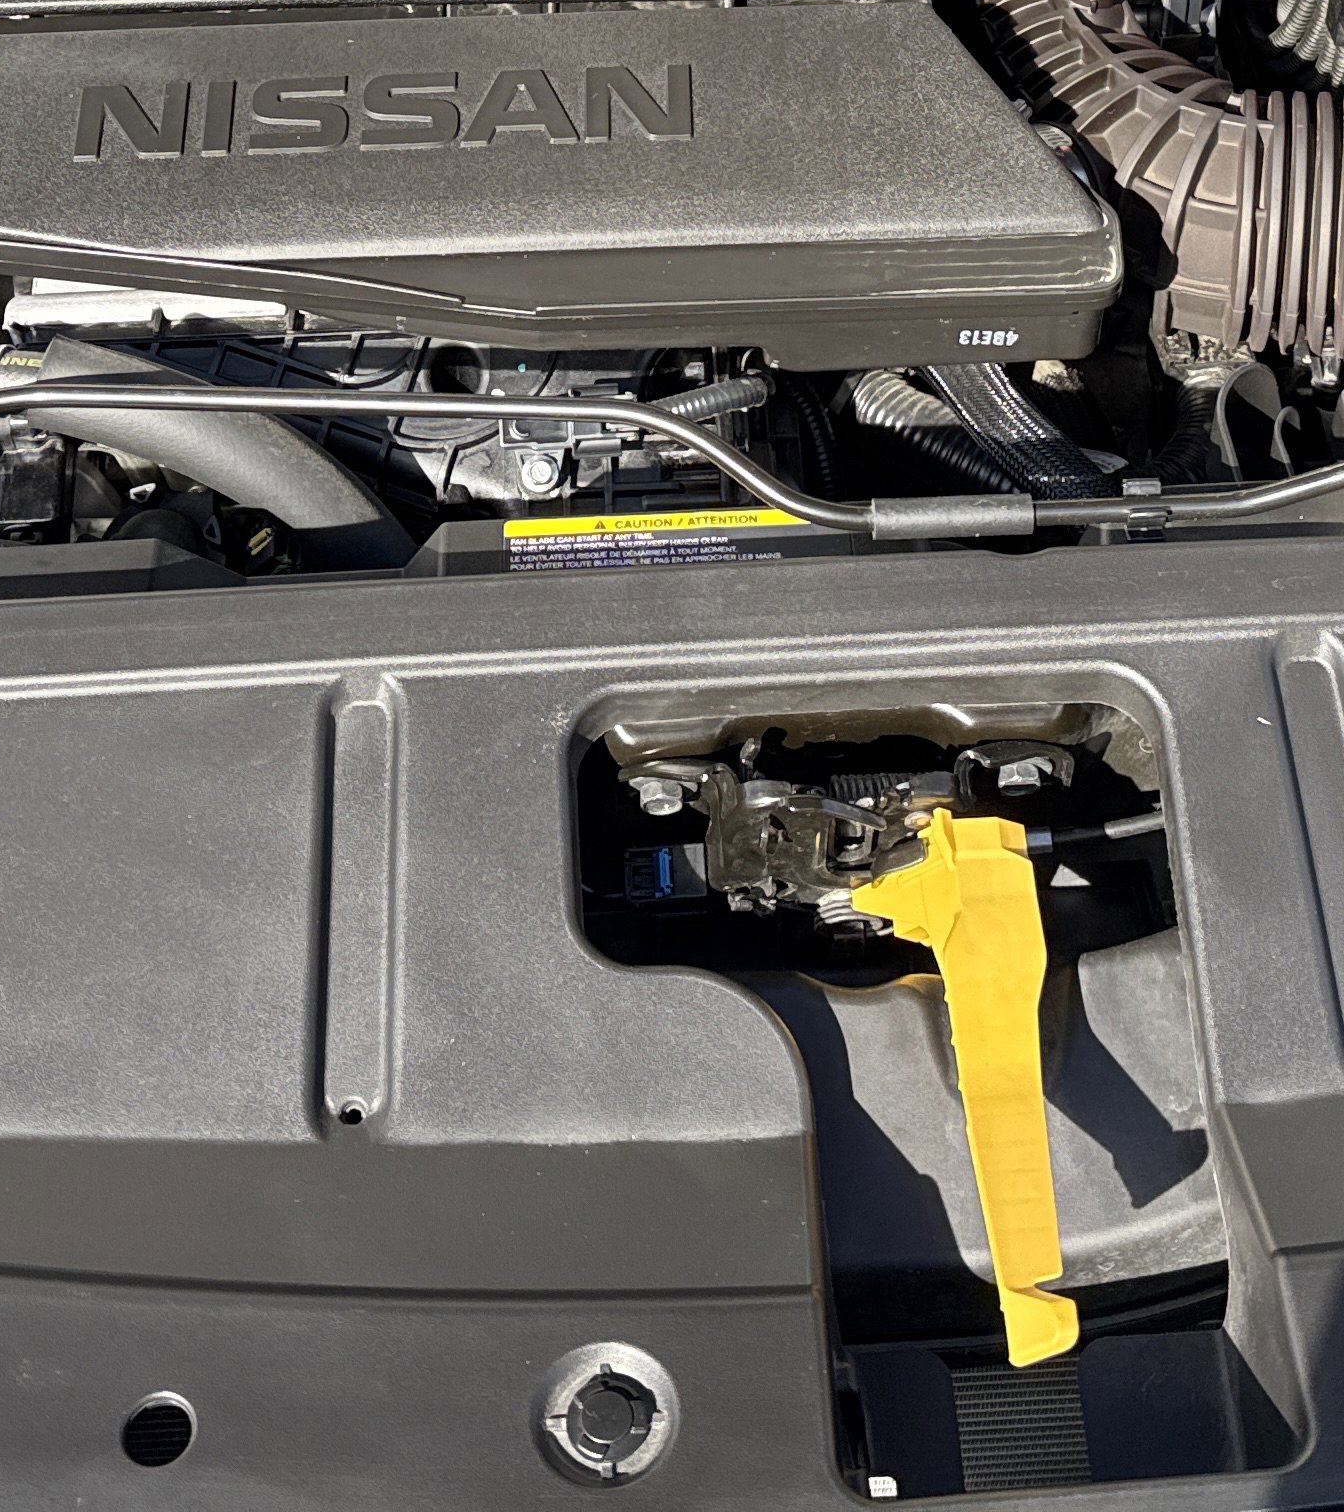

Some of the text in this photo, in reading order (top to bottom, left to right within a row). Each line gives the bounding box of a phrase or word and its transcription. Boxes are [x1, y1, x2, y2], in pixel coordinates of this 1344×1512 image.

[73, 63, 695, 163] NISSAN
[958, 329, 1020, 347] 4BE13
[614, 518, 673, 529] CAUTION
[687, 514, 758, 526] ATTENTION
[528, 536, 556, 545] BLADE
[556, 536, 575, 544] CAN
[576, 534, 601, 543] START
[603, 533, 614, 541] AT
[614, 532, 634, 541] ANY
[510, 555, 521, 563] LE
[521, 553, 575, 563] VENTILATEUR
[576, 551, 608, 560] RISQUE
[609, 550, 621, 558] DE
[677, 547, 698, 555] TOUT
[510, 563, 535, 571] POUR
[565, 560, 592, 568] TOUTE
